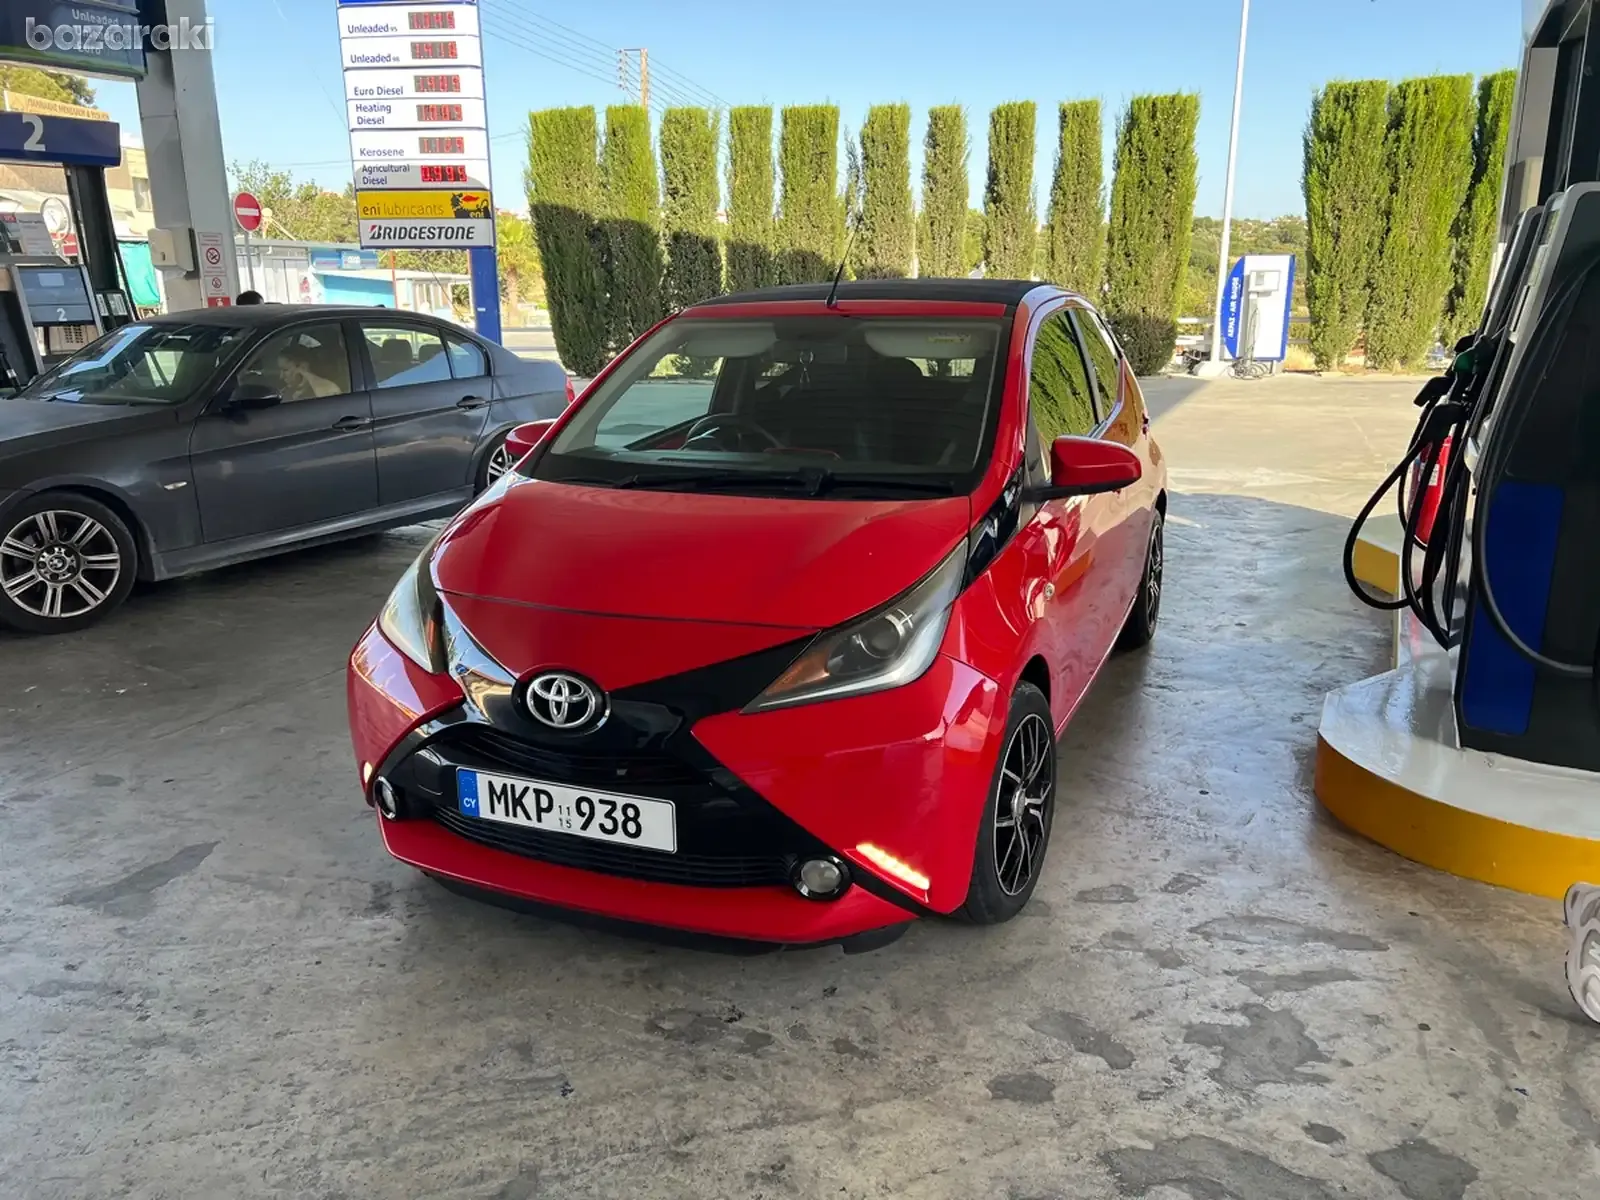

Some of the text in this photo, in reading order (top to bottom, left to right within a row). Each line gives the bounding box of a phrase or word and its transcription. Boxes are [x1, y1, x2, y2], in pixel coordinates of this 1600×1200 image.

[72, 9, 119, 26] Unleaded
[347, 24, 389, 33] Unleaded
[350, 54, 391, 63] Unleaded
[354, 86, 404, 96] Euro Diesel
[355, 103, 392, 114] Heating
[356, 116, 385, 125] Diesel
[22, 114, 46, 151] 2
[359, 148, 404, 157] Kerosene
[362, 164, 410, 174] Agricultural
[362, 176, 388, 185] Diesel
[362, 202, 445, 216] eni lubricants
[469, 210, 485, 218] eni
[368, 224, 475, 240] BRIDGESTONE
[57, 308, 67, 321] 2
[463, 797, 476, 808] CY
[487, 779, 642, 839] MKP 938
[558, 804, 571, 817] 11
[558, 817, 572, 829] 15
